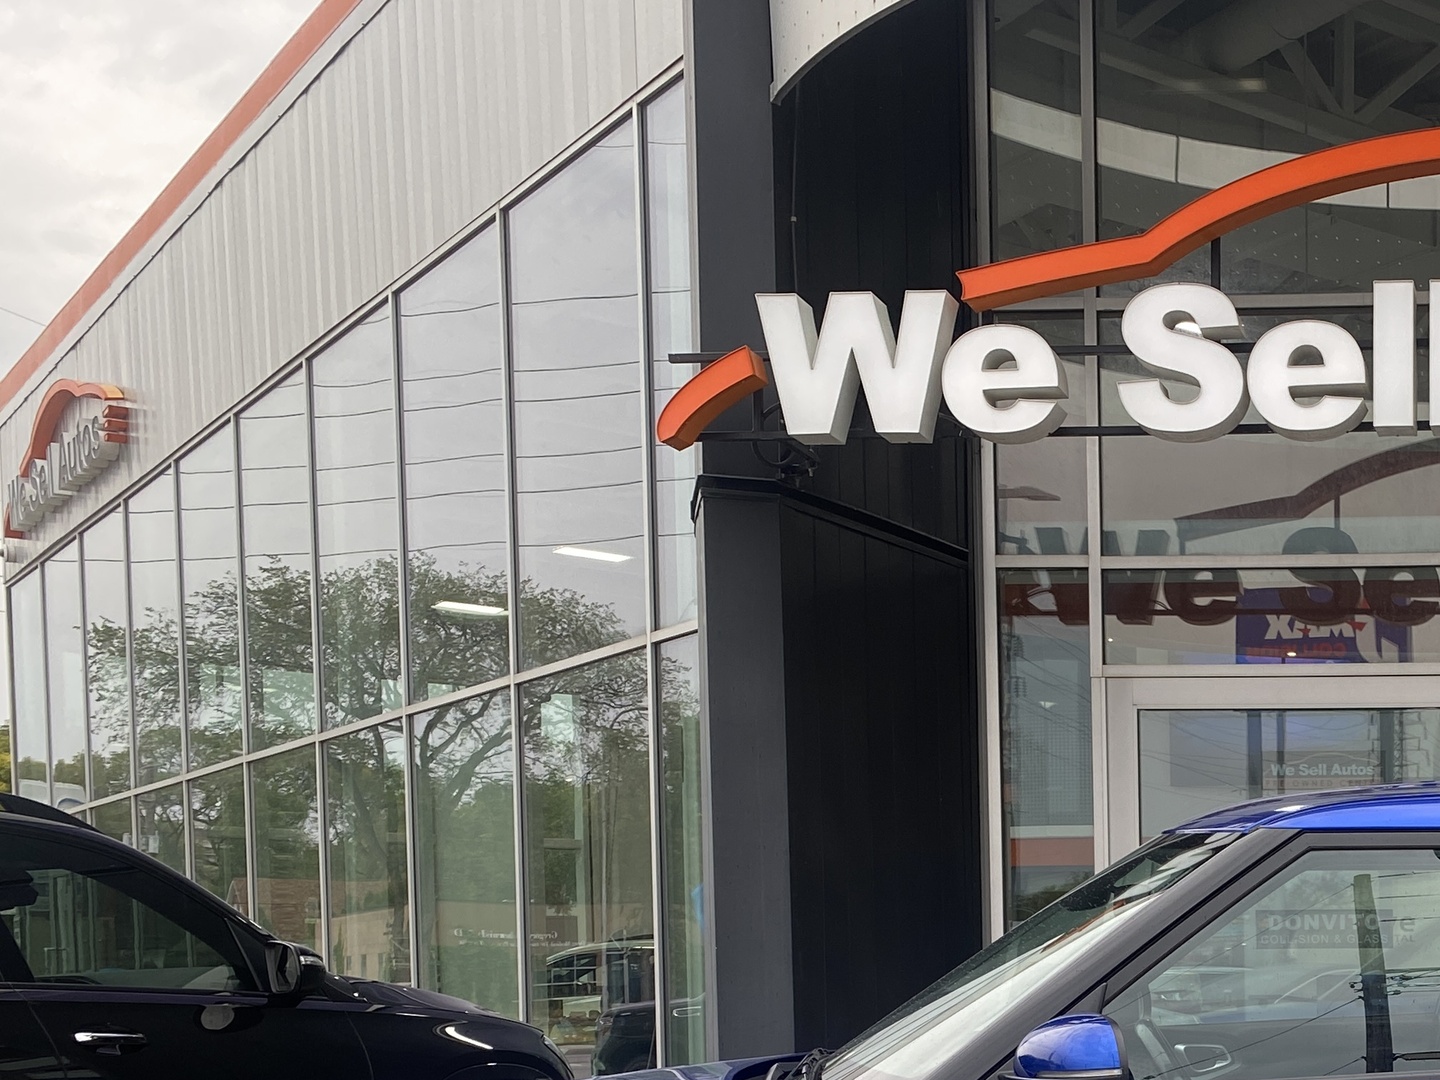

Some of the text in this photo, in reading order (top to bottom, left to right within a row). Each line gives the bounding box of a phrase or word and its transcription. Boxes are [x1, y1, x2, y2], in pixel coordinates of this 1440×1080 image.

[754, 290, 1068, 445] We
[8, 416, 106, 528] We Sell Autos
[1270, 763, 1375, 777] We Sell Autos
[1267, 913, 1380, 931] DONVITO
[1260, 934, 1388, 944] COLLISION & GLASS
